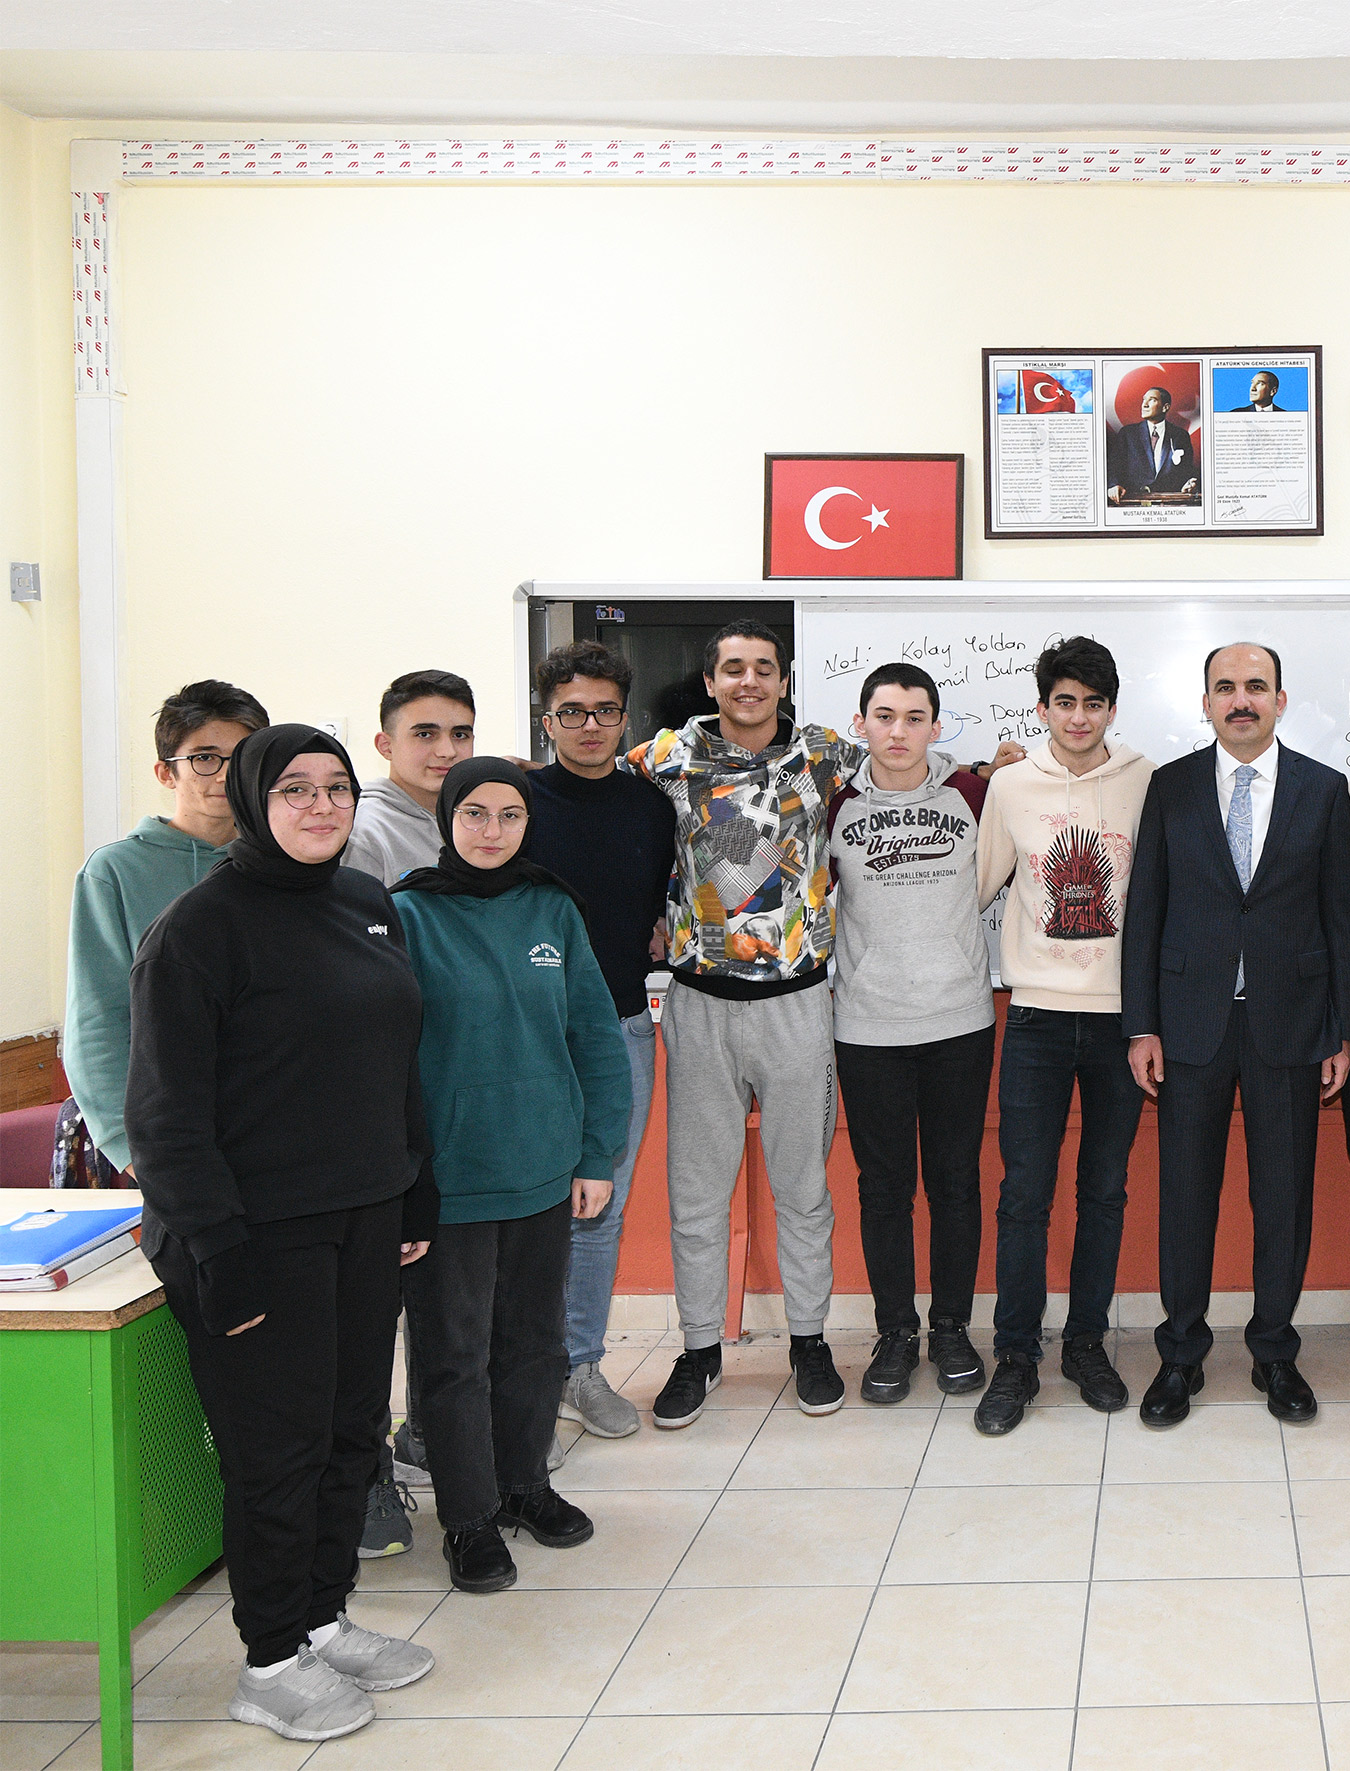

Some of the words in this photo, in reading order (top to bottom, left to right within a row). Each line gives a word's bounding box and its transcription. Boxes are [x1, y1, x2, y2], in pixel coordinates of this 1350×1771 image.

[900, 636, 952, 668] Kolay
[964, 632, 1026, 653] Yoldan
[903, 808, 917, 826] &
[917, 808, 970, 840] BRAVE
[867, 830, 951, 856] Originals
[863, 874, 874, 882] THE
[875, 873, 895, 881] GREAT
[897, 871, 931, 880] CHALLENGE
[932, 869, 957, 877] ARIZONA
[1061, 889, 1095, 899] THRONES
[1063, 882, 1088, 892] GAME
